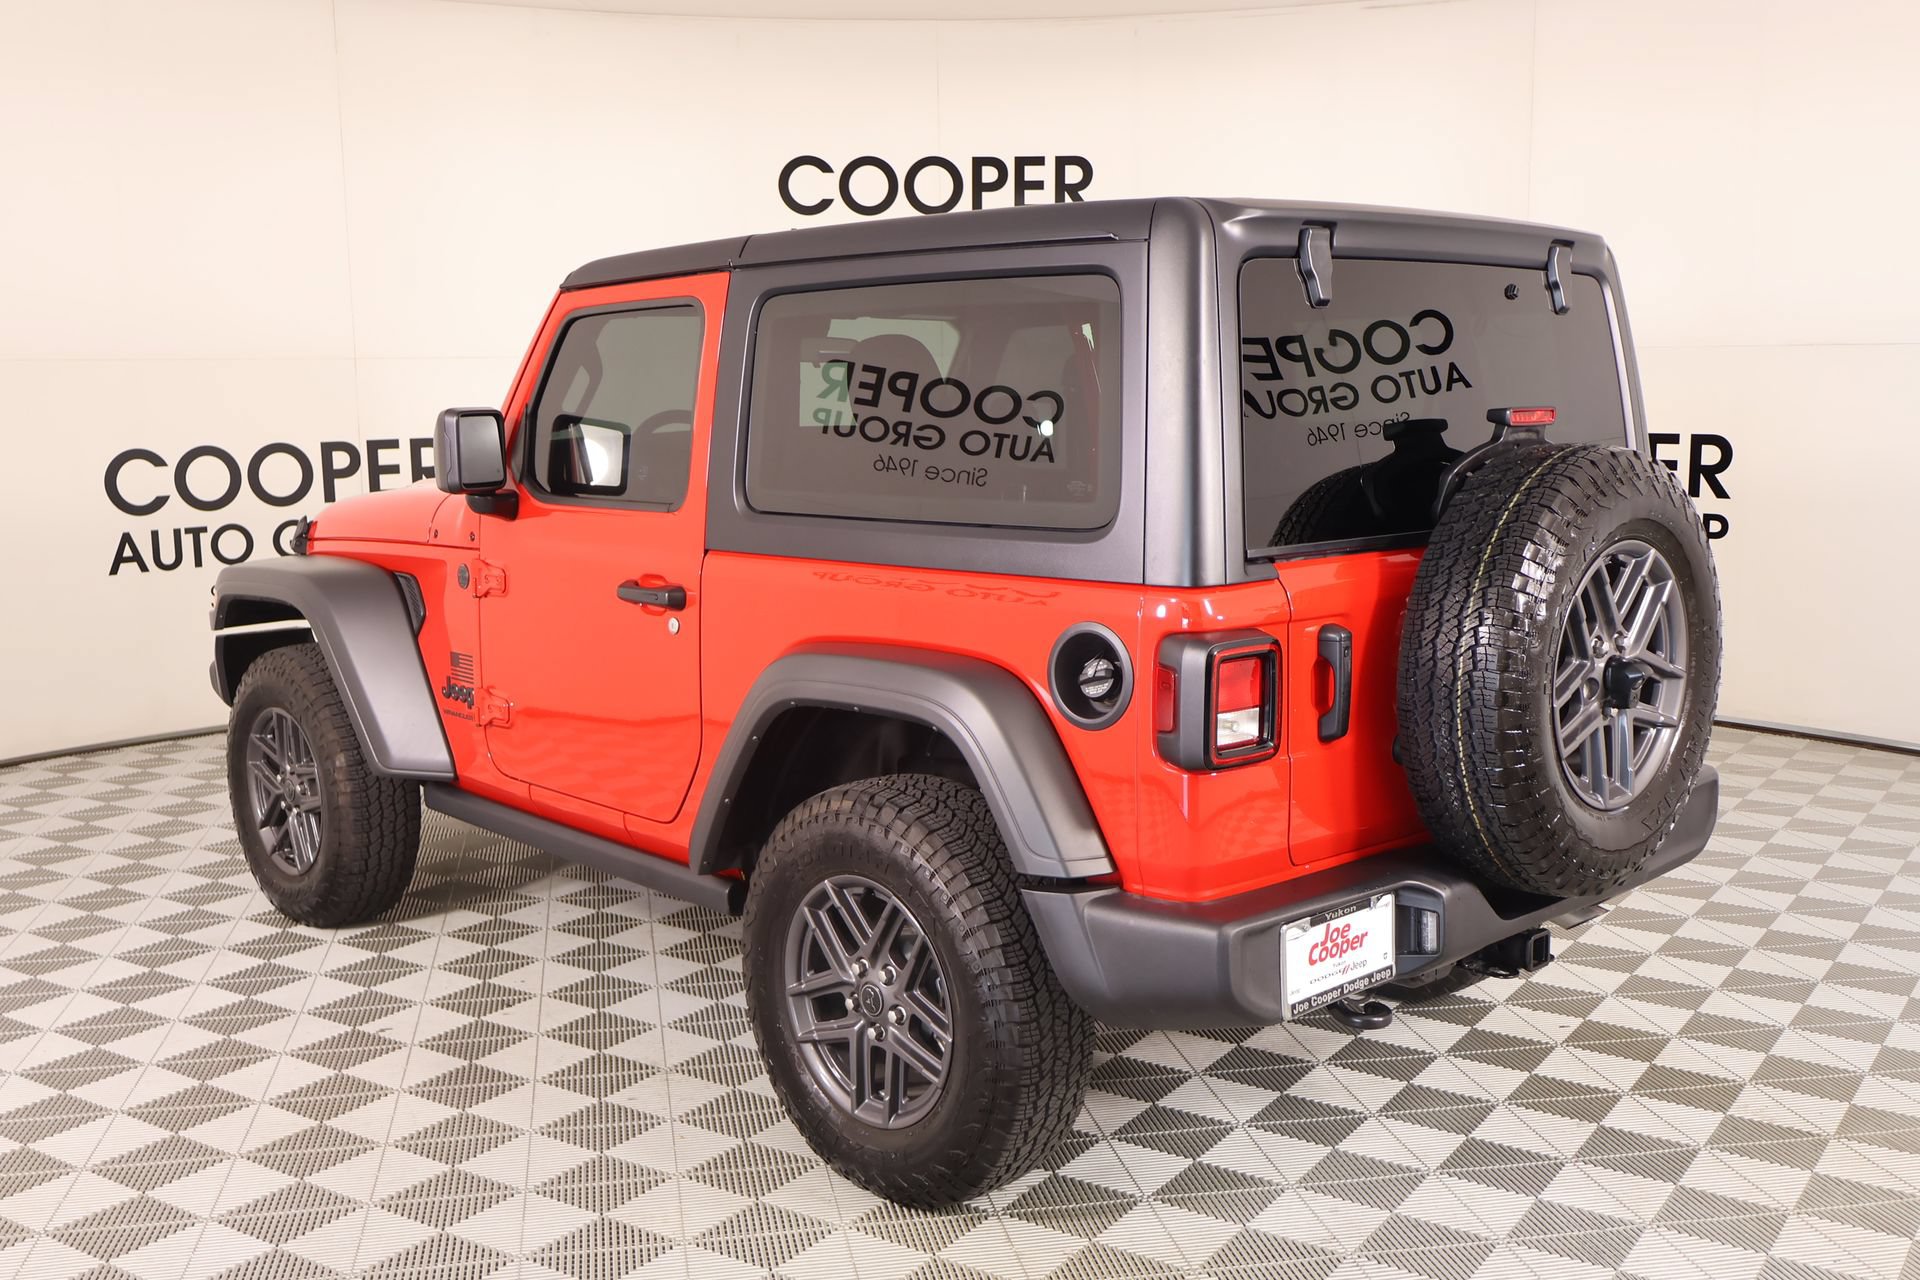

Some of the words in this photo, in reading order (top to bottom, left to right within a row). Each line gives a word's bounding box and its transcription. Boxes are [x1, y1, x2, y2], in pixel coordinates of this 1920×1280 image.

[778, 155, 1093, 216] COOPER
[108, 523, 254, 576] AUTO
[442, 676, 475, 710] Jeep
[1325, 905, 1357, 921] Yukon
[1308, 931, 1369, 966] Cooper
[1319, 923, 1351, 947] Joe
[1293, 1001, 1309, 1015] Joe
[1311, 988, 1342, 1007] Cooper
[1343, 976, 1370, 994] Dodge
[1371, 968, 1392, 983] Jeep
